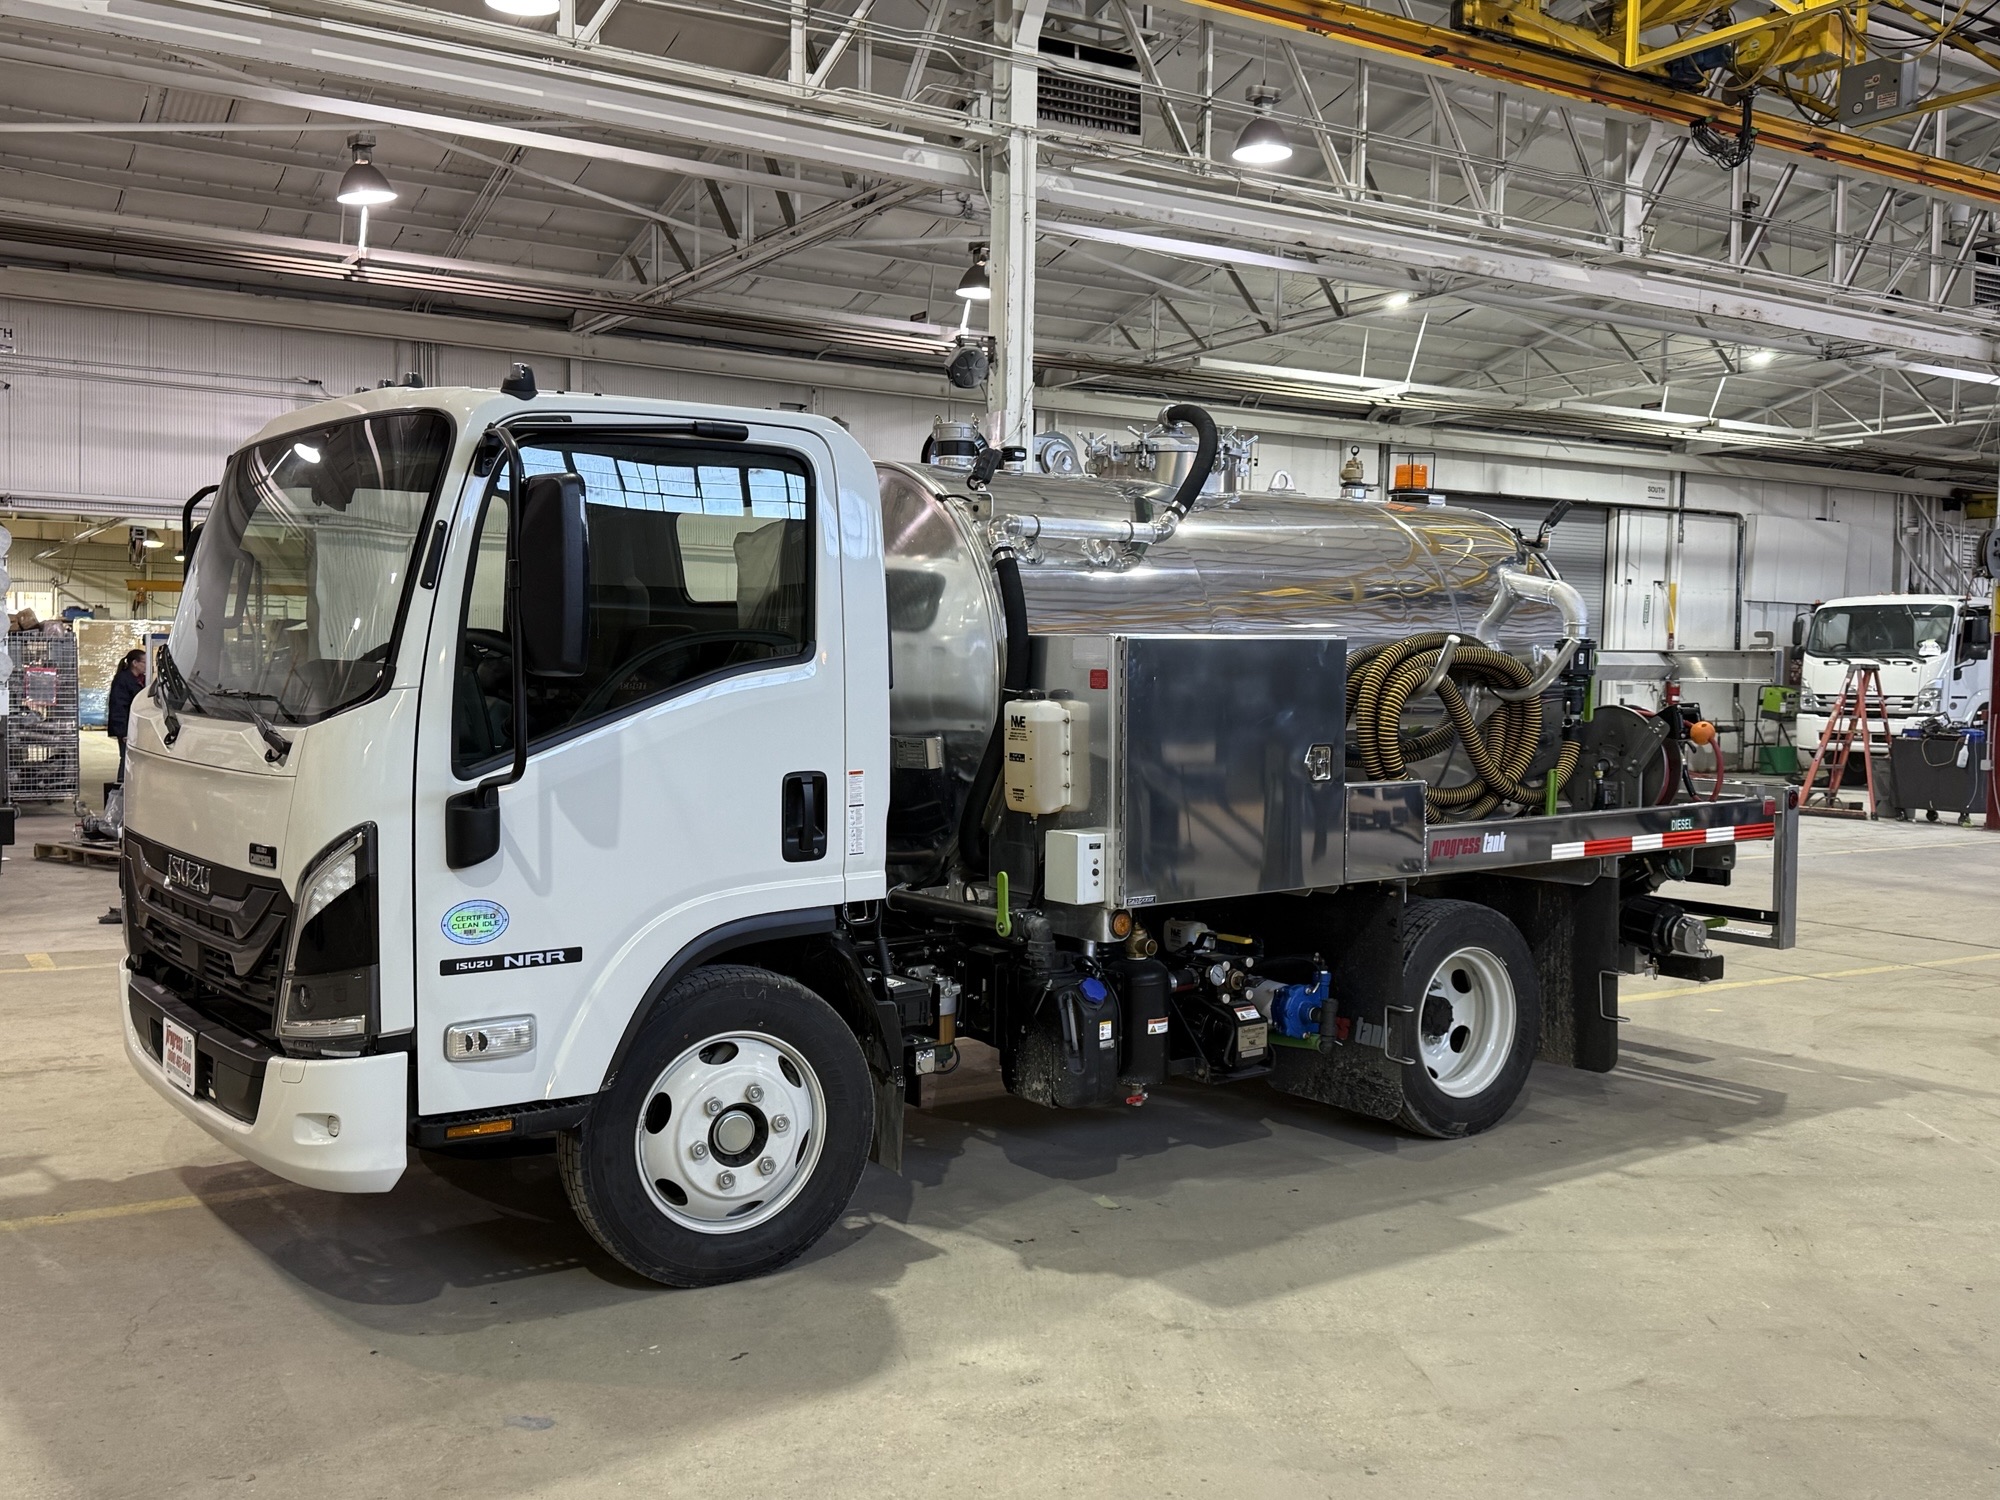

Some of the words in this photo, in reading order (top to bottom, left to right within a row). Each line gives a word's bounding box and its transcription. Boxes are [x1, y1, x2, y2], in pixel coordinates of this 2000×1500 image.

[1647, 485, 1666, 494] SOUTH
[1671, 818, 1693, 831] DIESEL
[1430, 836, 1482, 861] progress
[1482, 831, 1508, 853] tank
[168, 854, 211, 895] ISUZU
[451, 922, 479, 930] CLEAN
[482, 919, 501, 927] IDLE
[455, 913, 497, 923] CERTIFIED
[456, 960, 494, 971] ISUZU
[503, 950, 566, 968] NRR
